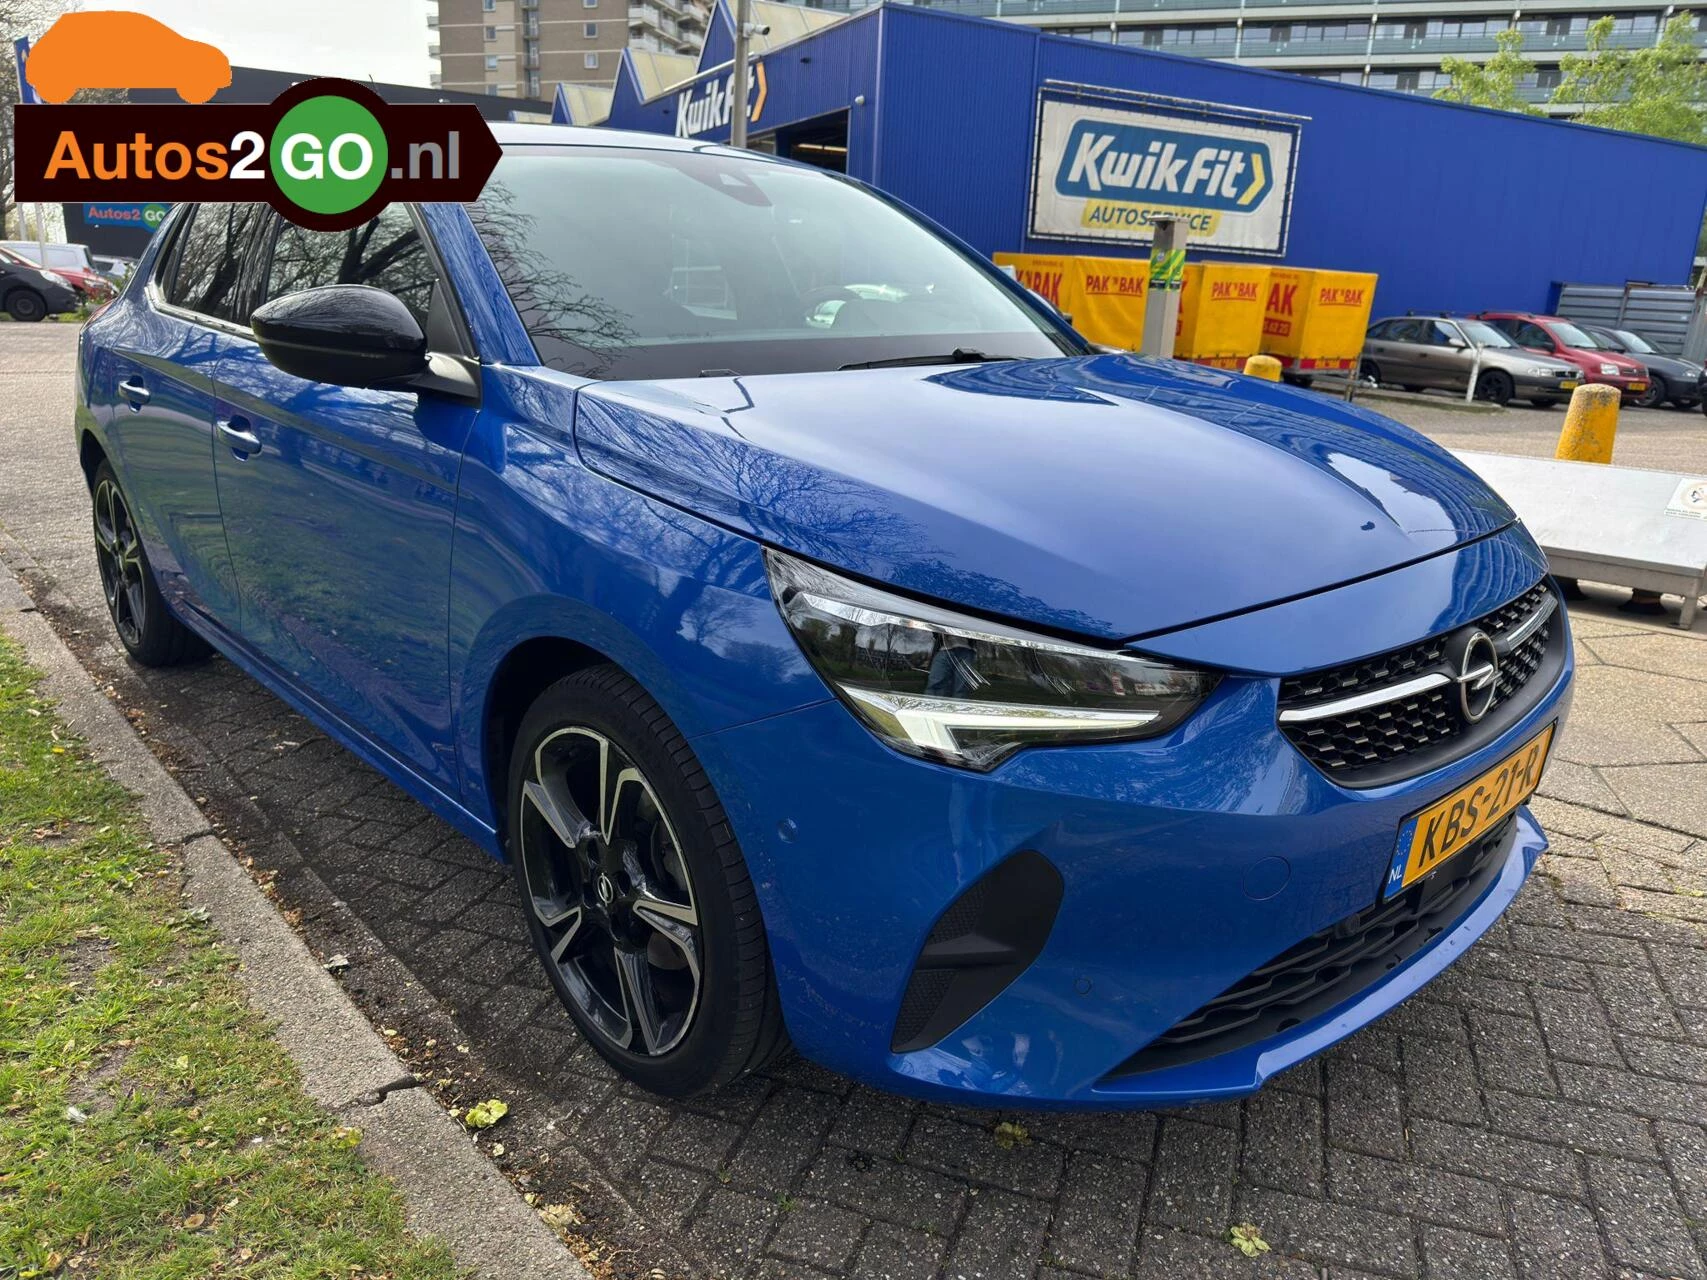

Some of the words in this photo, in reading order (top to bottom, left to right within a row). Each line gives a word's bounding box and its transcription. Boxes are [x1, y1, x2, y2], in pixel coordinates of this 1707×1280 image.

[1089, 205, 1212, 231] AUTOSCE
[1085, 275, 1110, 291] PAK
[1119, 277, 1144, 293] BAK
[1212, 281, 1231, 297] PAK
[1238, 282, 1258, 298] BAK
[1320, 287, 1339, 303] PAK
[1344, 289, 1364, 304] BAK
[1418, 744, 1540, 869] KBS-21-R
[1388, 863, 1403, 884] NL
